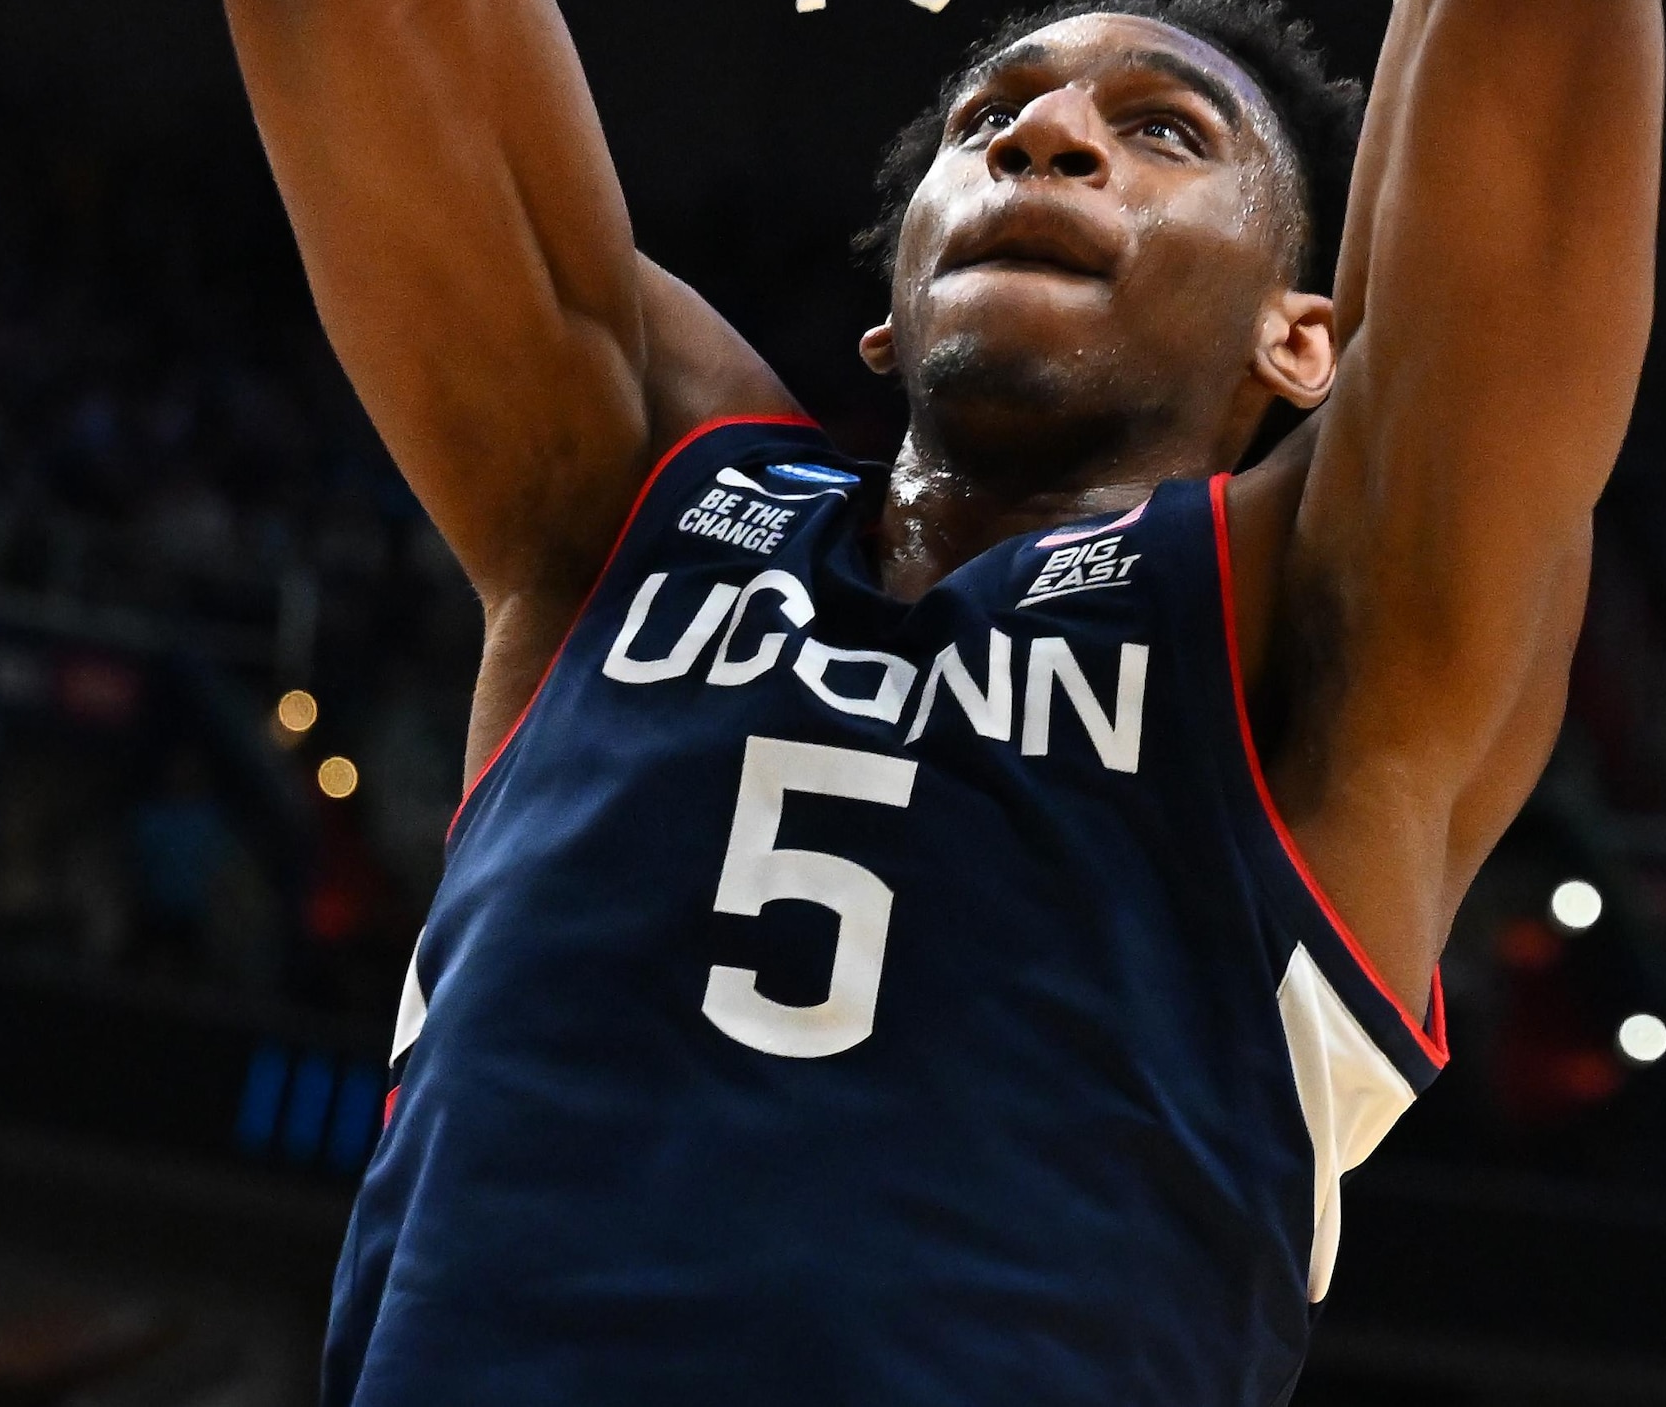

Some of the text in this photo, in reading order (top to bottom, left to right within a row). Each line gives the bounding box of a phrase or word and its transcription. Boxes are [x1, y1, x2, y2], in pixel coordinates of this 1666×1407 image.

[677, 507, 785, 555] CHANGE
[699, 488, 796, 531] BE THE
[1026, 553, 1142, 596] EAST
[1040, 534, 1125, 574] BIG
[601, 568, 1150, 775] UCONN
[701, 734, 920, 1060] 5
